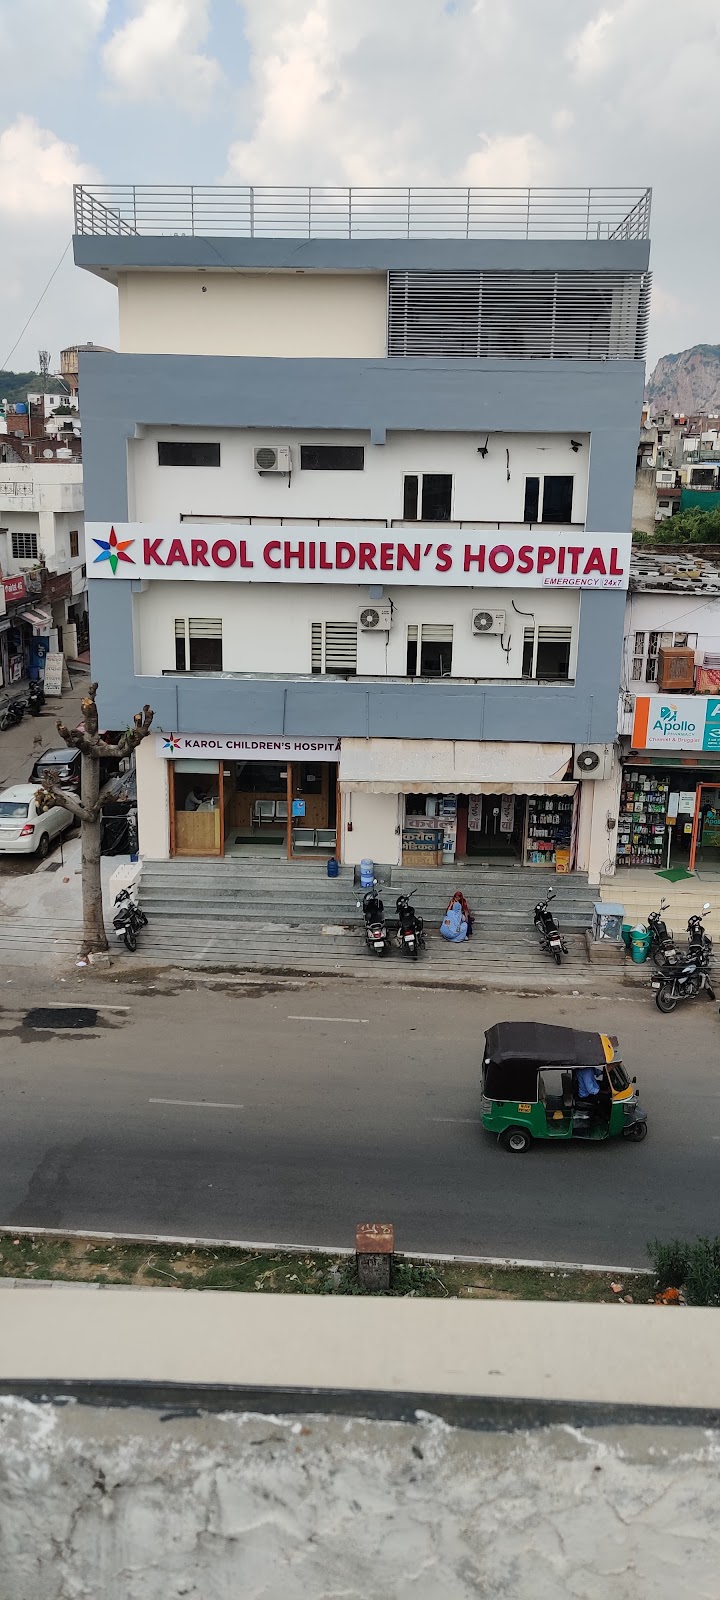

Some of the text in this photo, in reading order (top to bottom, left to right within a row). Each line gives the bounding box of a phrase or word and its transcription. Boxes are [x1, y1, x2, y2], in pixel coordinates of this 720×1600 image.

[143, 538, 624, 575] KAROL CHILDREN'S HOSPITAL
[543, 577, 622, 587] EMERGENCY 24x7
[653, 720, 696, 736] Apollo
[184, 739, 342, 752] KAROL CHILDREN'S HOSPITA
[402, 832, 436, 841] करोल
